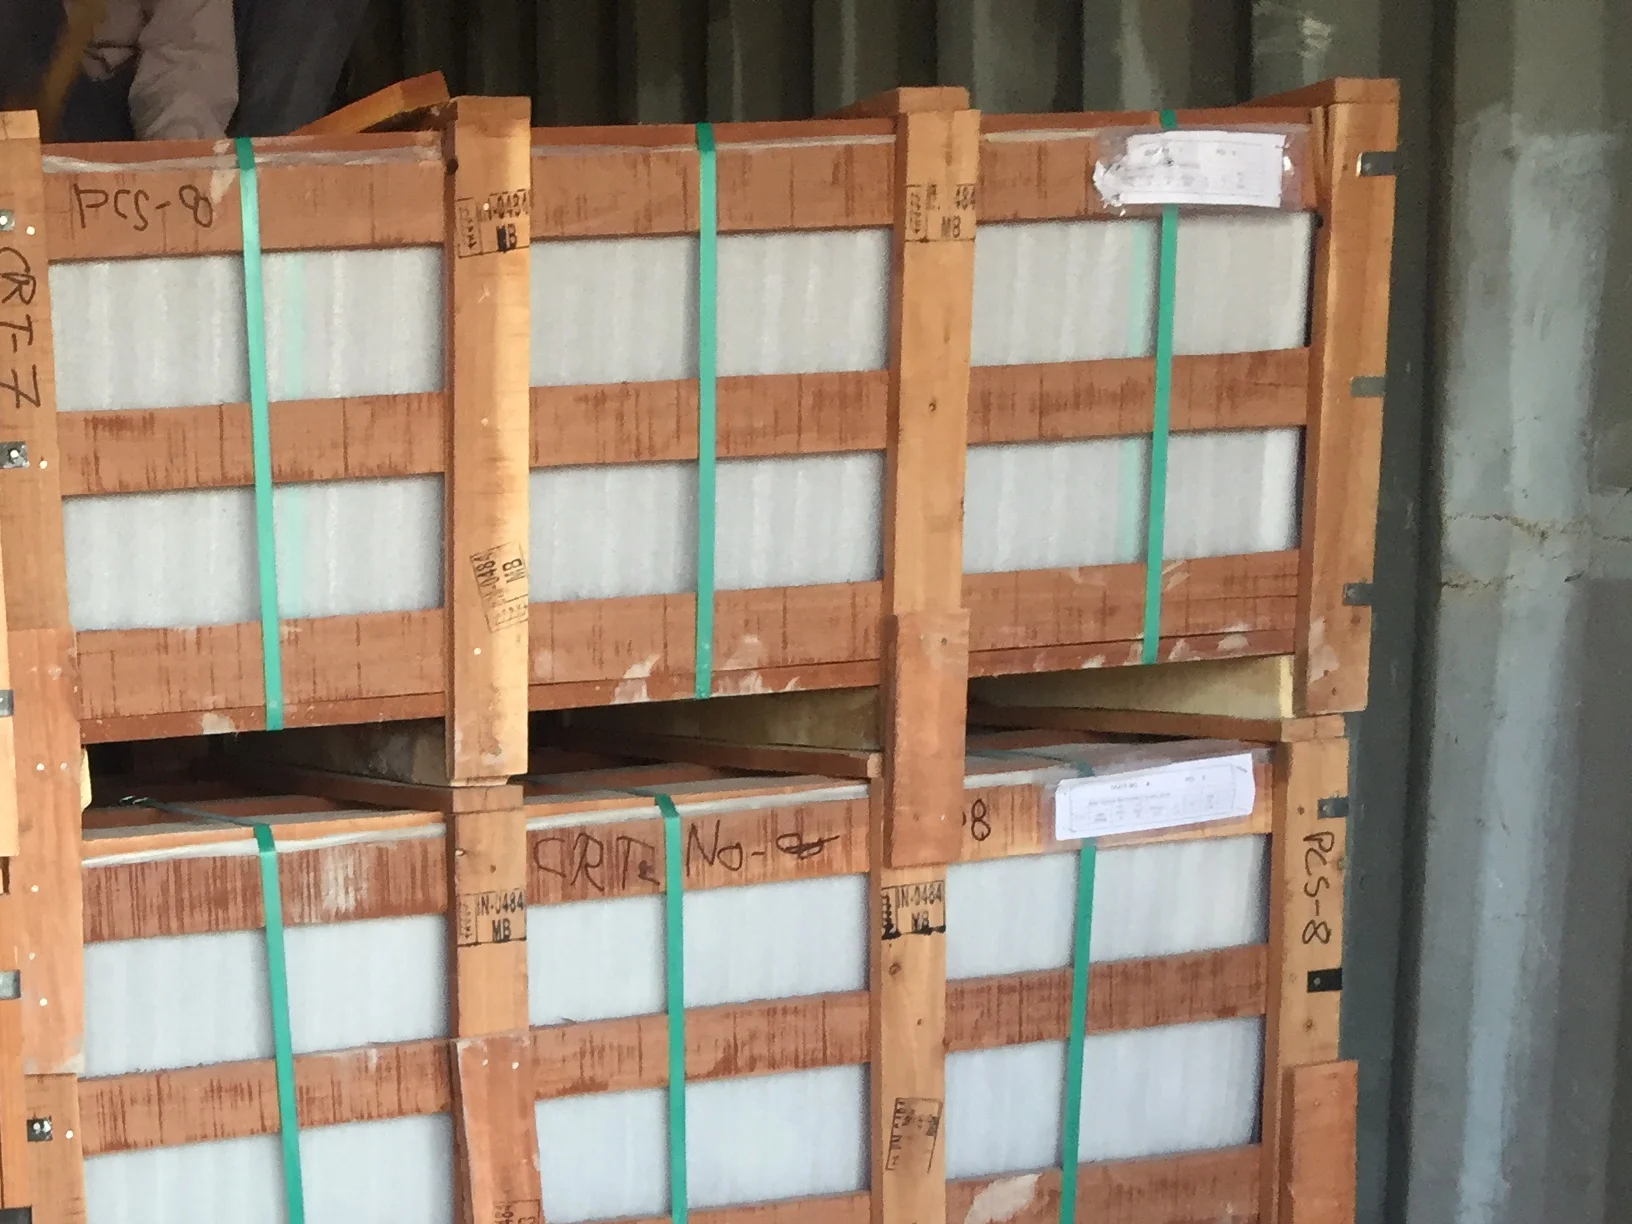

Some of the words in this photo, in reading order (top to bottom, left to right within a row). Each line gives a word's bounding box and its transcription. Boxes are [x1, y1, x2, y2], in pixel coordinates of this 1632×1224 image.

[73, 183, 214, 232] PCS-8
[1302, 831, 1334, 945] PCS-8
[492, 918, 511, 943] MB
